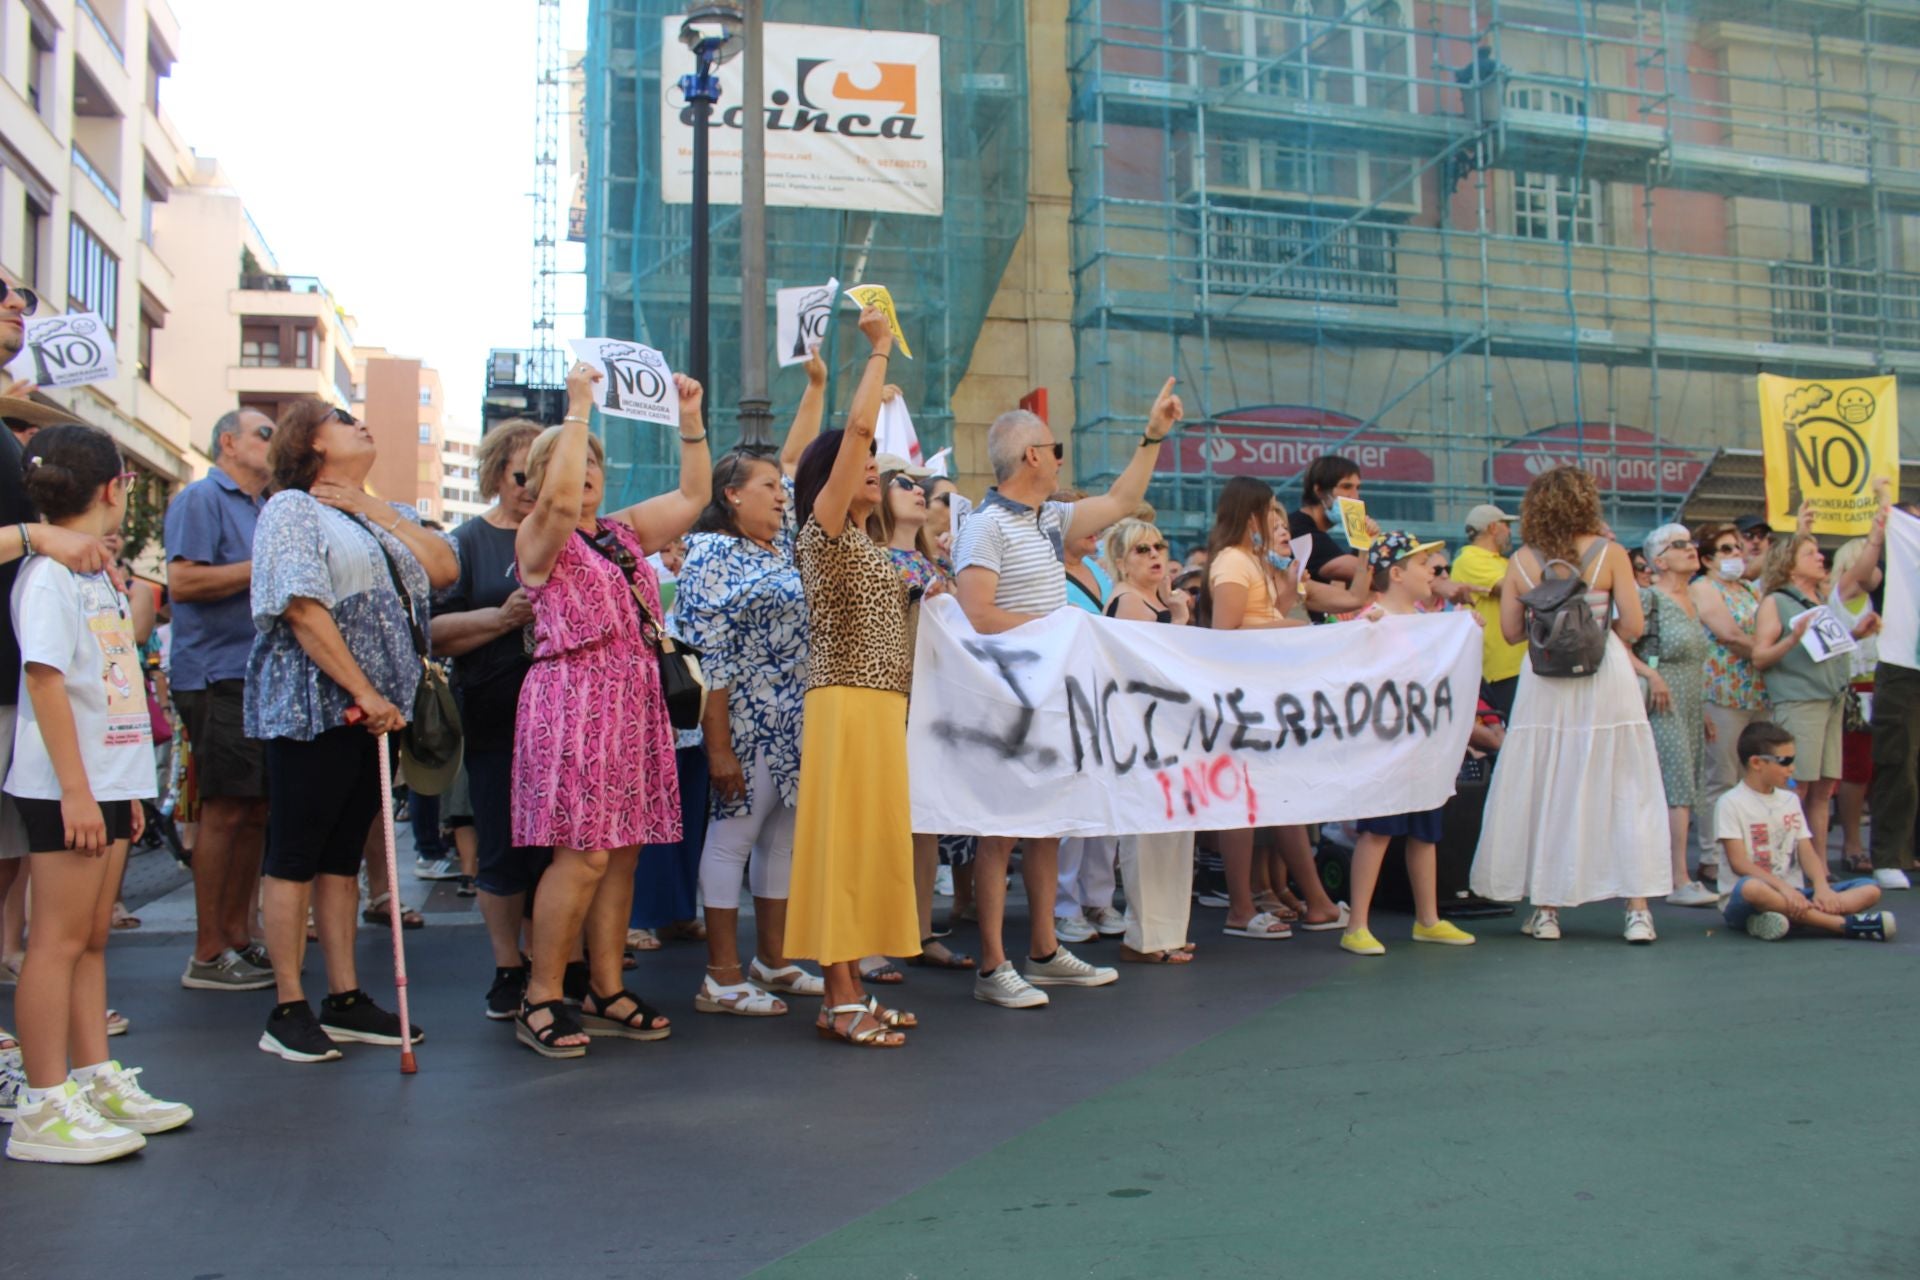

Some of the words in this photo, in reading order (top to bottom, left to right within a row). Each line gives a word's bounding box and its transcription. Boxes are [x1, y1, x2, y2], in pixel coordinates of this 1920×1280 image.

[34, 341, 94, 371] NO
[606, 361, 659, 399] NO
[621, 399, 670, 413] INCINERADORA
[1241, 438, 1390, 468] Santader
[1788, 431, 1859, 490] NO
[1561, 456, 1688, 482] Snander
[1844, 511, 1875, 522] CASTR
[1815, 622, 1843, 641] NO
[930, 637, 1454, 775] INCINERADORA
